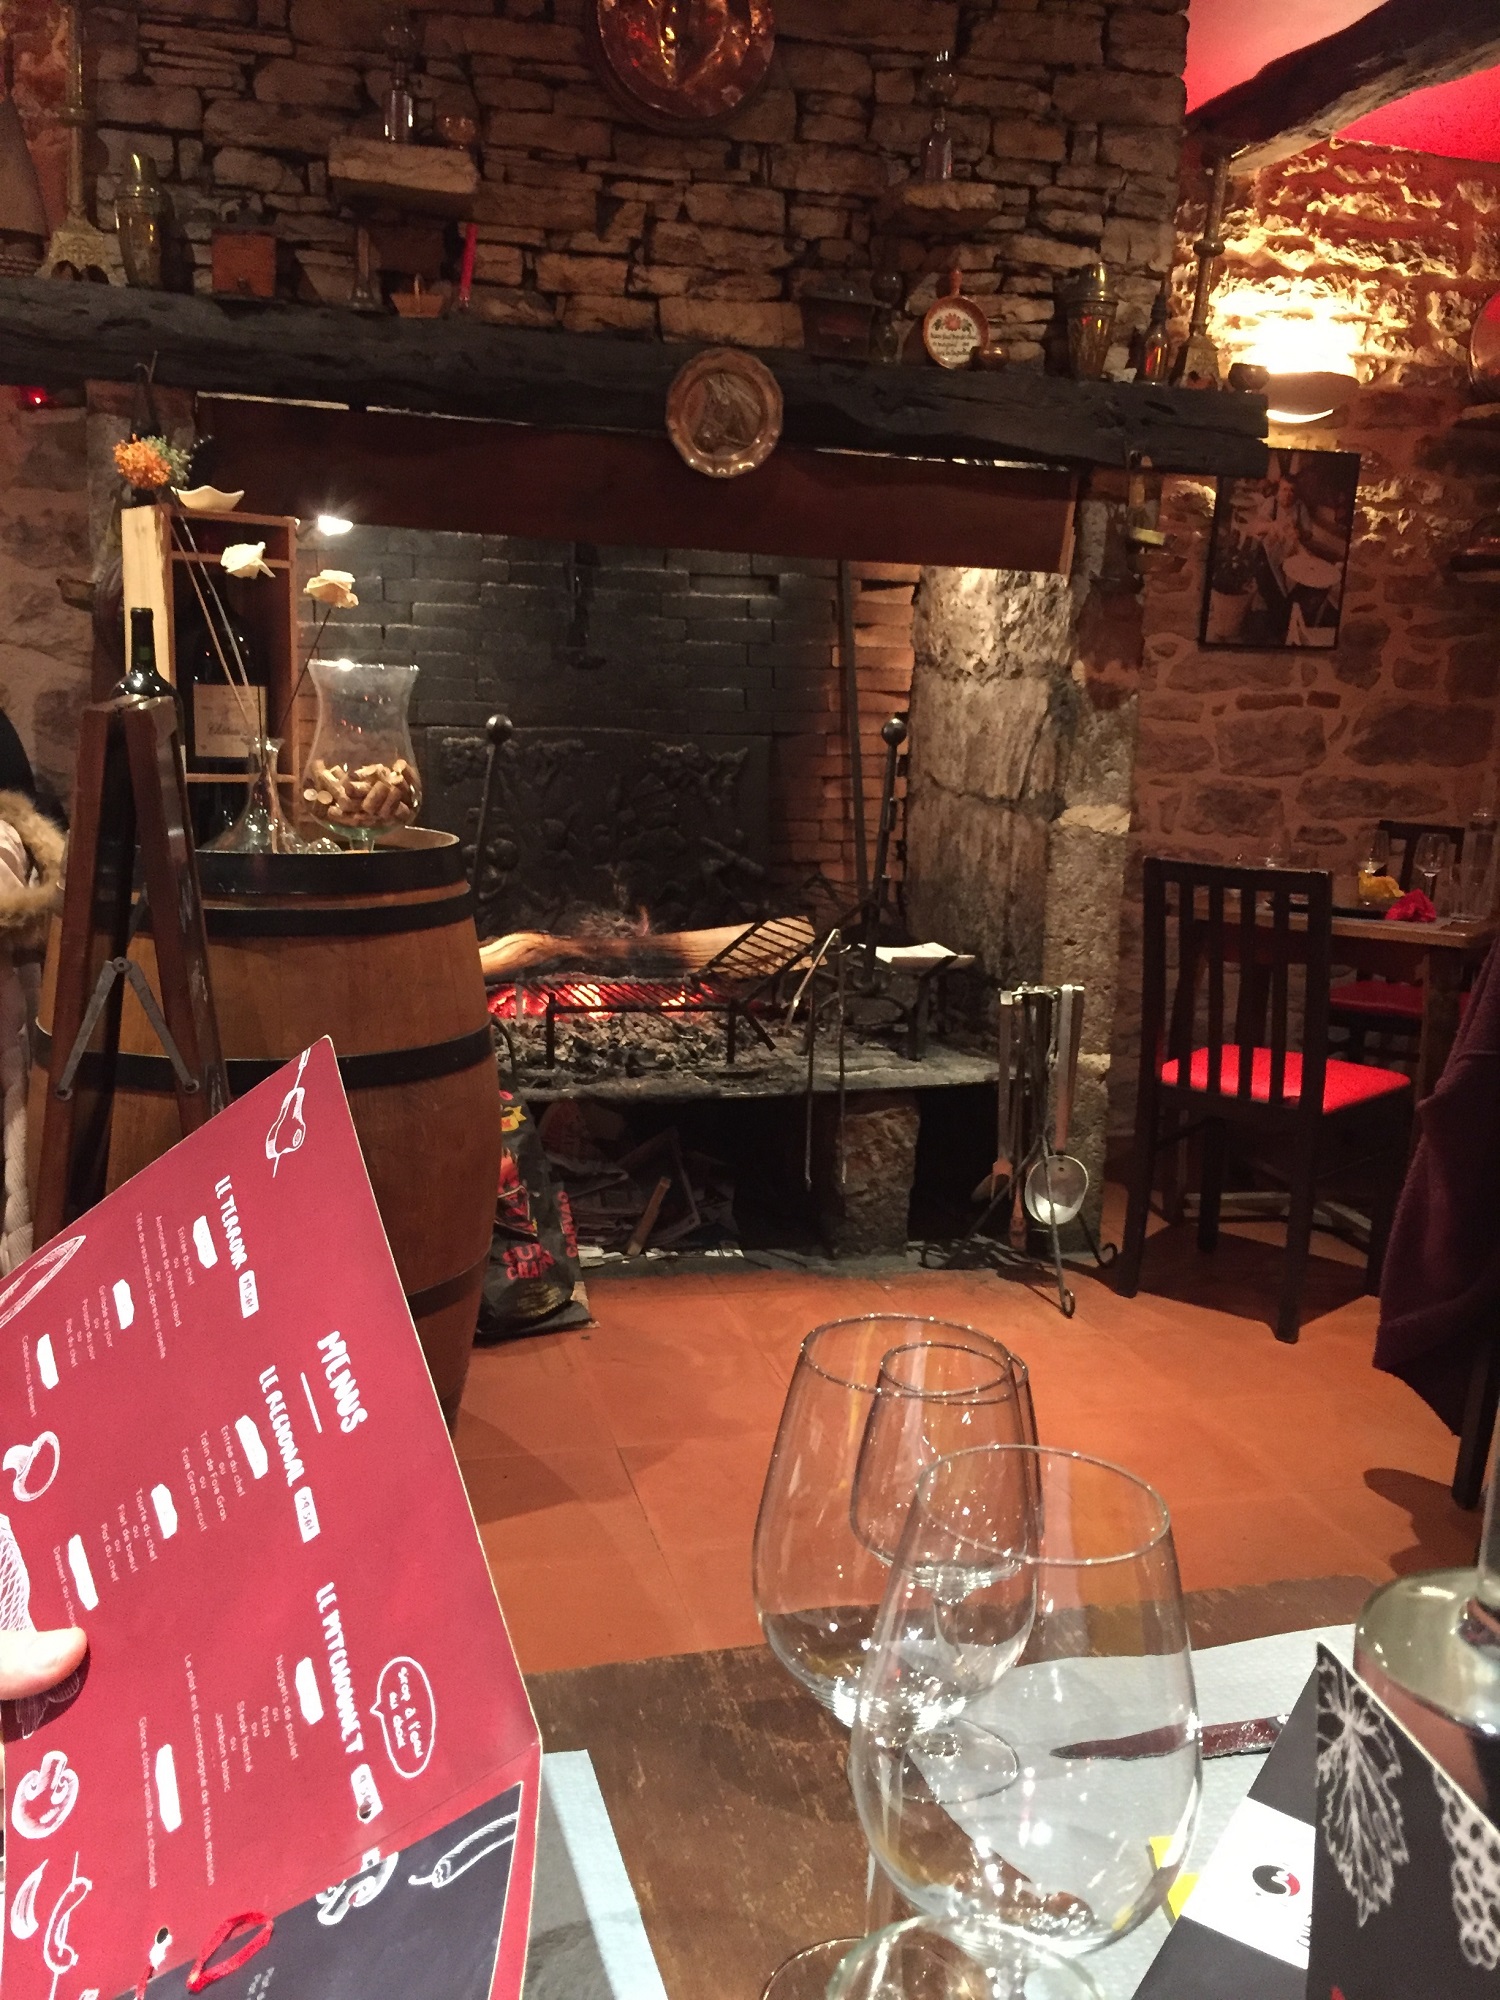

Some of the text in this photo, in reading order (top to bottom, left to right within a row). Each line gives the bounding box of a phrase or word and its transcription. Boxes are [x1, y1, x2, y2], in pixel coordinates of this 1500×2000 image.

[138, 1231, 144, 1243] de
[214, 1174, 247, 1270] LE TERROIR
[173, 1257, 179, 1268] ou
[177, 1226, 194, 1285] Entrée du chef
[143, 1263, 152, 1288] sauce
[154, 1270, 161, 1282] ou
[162, 1258, 169, 1269] de
[171, 1300, 182, 1327] chaud
[81, 1298, 95, 1359] Poisson du jour
[93, 1317, 99, 1328] ou
[98, 1284, 112, 1347] Grillade du jour
[153, 1318, 160, 1330] ou
[67, 1335, 74, 1347] du
[76, 1330, 82, 1342] ou
[156, 1331, 166, 1359] oseille
[69, 1348, 78, 1367] chef
[25, 1372, 31, 1384] ou
[316, 1330, 367, 1433] MENUS
[27, 1384, 37, 1417] dessert
[258, 1364, 304, 1487] LE REGIONAL
[200, 1430, 226, 1521] Tatin de Foie Gras
[218, 1461, 226, 1475] ou
[220, 1424, 245, 1496] Entrée du chef
[181, 1447, 207, 1531] Foie Gras mi-cuit
[199, 1475, 206, 1489] ou
[117, 1503, 127, 1526] Filet
[122, 1528, 130, 1542] de
[132, 1524, 139, 1538] ou
[135, 1487, 157, 1561] Tourte du chef
[100, 1522, 119, 1582] Plat du chef
[113, 1539, 120, 1552] ou
[52, 1545, 67, 1584] Dessert
[62, 1585, 69, 1598] au
[184, 1653, 191, 1668] Le
[315, 1581, 364, 1753] LE PITCHOUNET
[186, 1669, 196, 1692] plat
[190, 1694, 198, 1711] est
[271, 1707, 279, 1721] ou
[275, 1654, 298, 1760] Nuggets de poulet
[404, 1707, 416, 1719] à
[138, 1716, 147, 1749] Glace
[236, 1700, 252, 1772] Steak haché
[250, 1721, 258, 1736] ou
[260, 1705, 270, 1737] Pizza
[214, 1713, 230, 1792] Jambon blanc
[229, 1736, 236, 1751] ou
[407, 1720, 423, 1758] l'eau
[144, 1781, 153, 1818] vanille
[201, 1789, 208, 1804] de
[146, 1820, 153, 1836] au
[202, 1806, 211, 1839] frites
[147, 1837, 157, 1889] chocolat
[205, 1840, 214, 1885] maison
